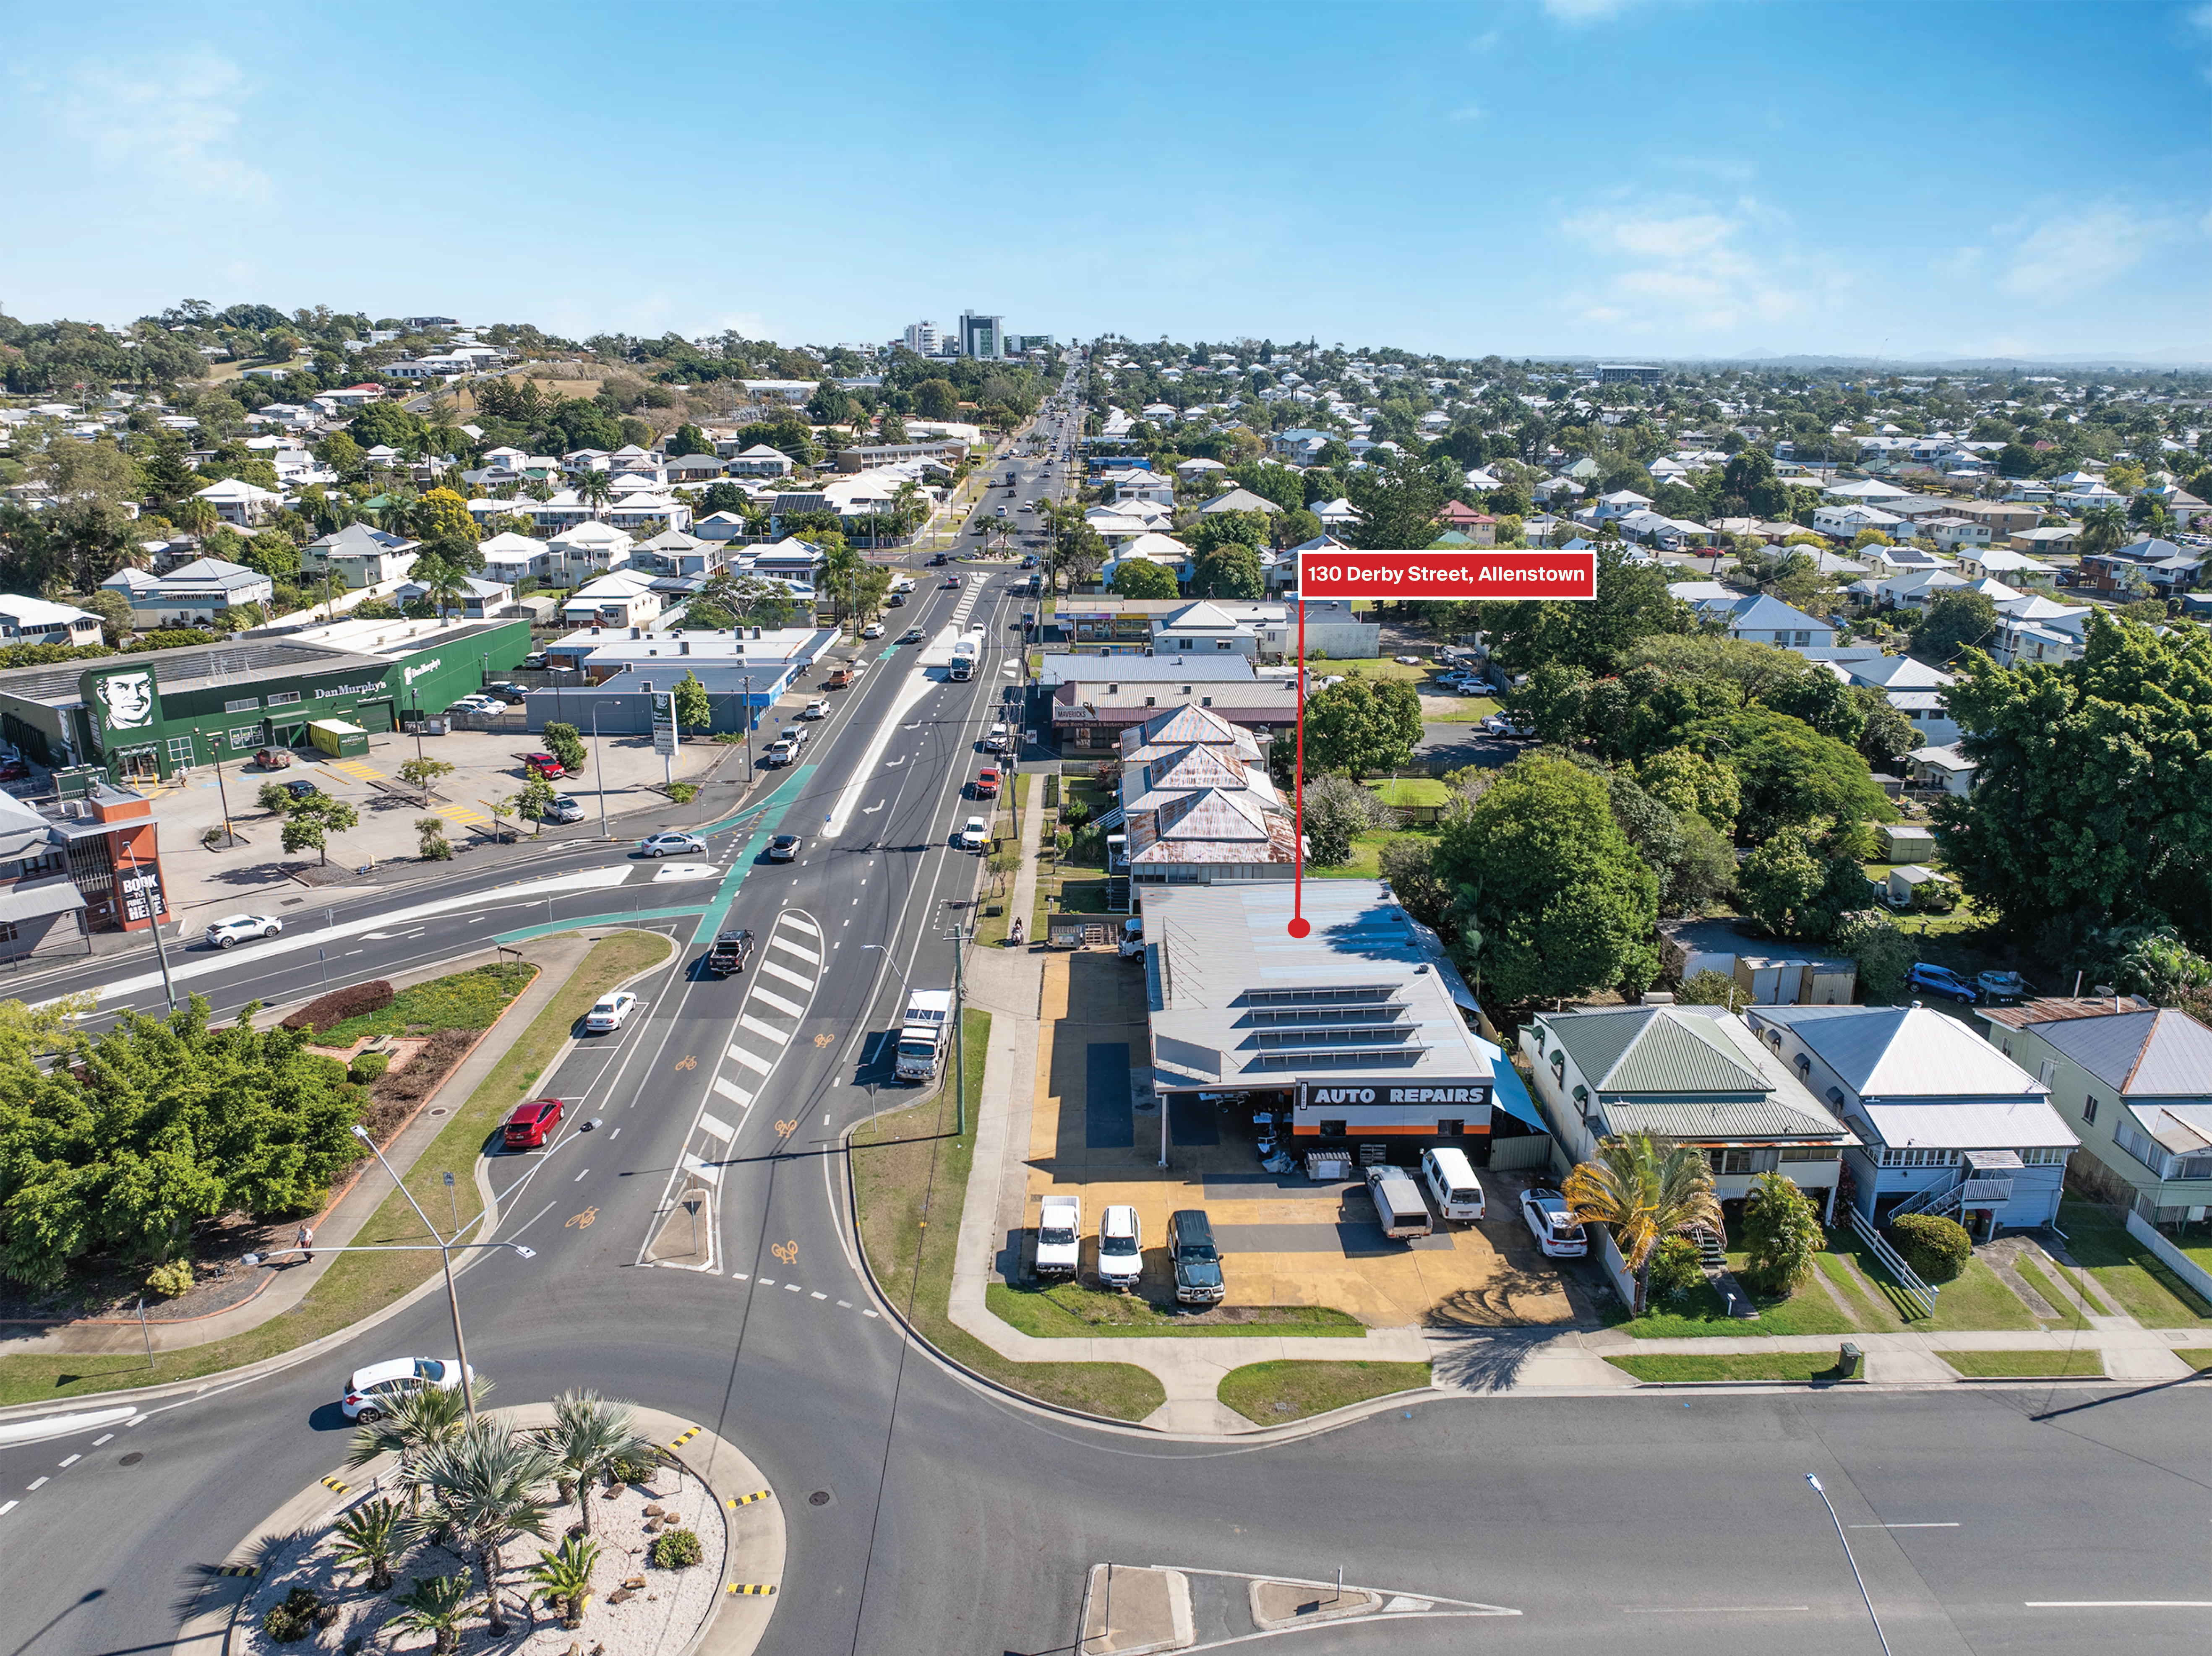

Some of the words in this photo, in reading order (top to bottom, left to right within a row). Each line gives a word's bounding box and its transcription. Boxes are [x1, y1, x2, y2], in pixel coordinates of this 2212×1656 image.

[123, 874, 158, 893] BOOK
[1315, 1088, 1376, 1103] AUTO
[1390, 1088, 1484, 1103] REPAIRS
